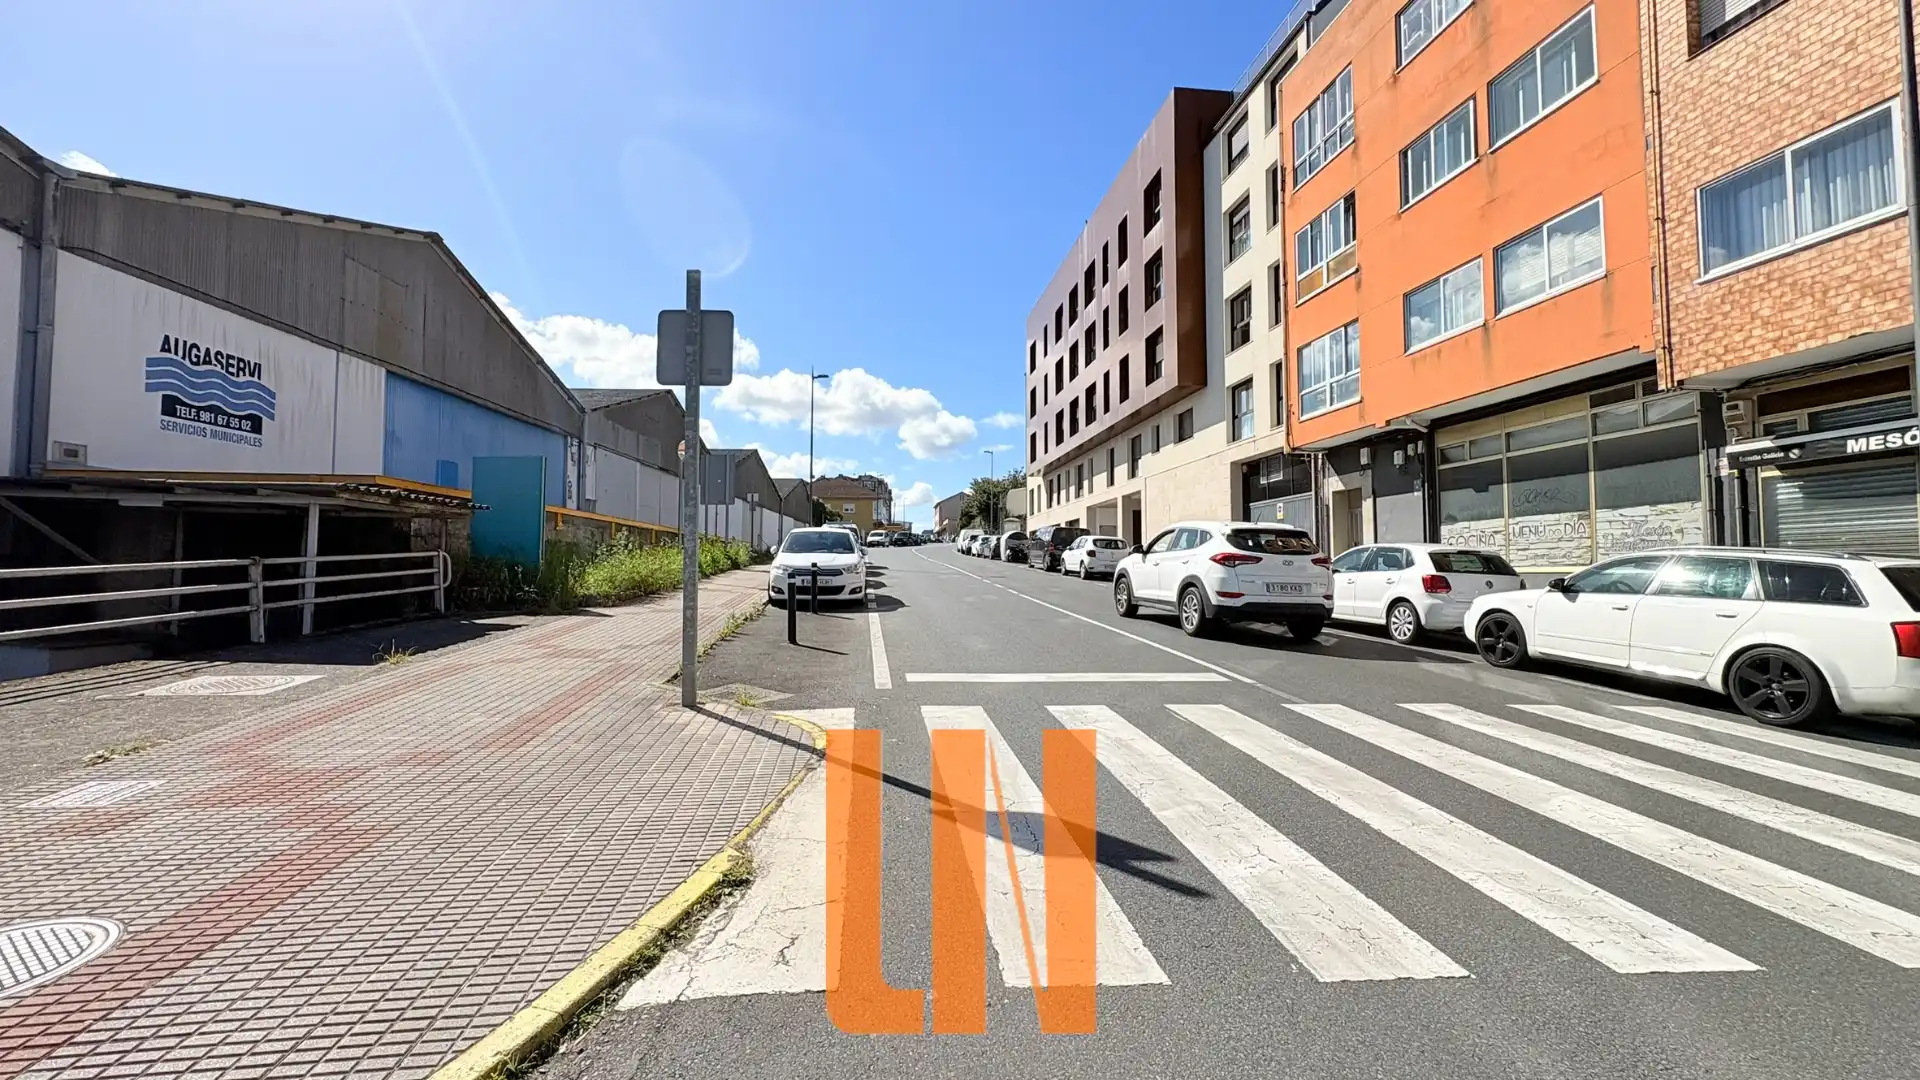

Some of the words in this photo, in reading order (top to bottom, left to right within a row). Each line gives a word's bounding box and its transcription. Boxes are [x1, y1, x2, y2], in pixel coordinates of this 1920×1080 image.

[160, 334, 262, 381] AUGASERVI
[175, 405, 198, 420] TELF.
[199, 410, 215, 423] 981
[218, 414, 228, 426] 67
[229, 416, 240, 428] 55
[241, 419, 252, 431] 02
[159, 419, 207, 438] SERVICIOS
[210, 428, 263, 448] MUNICIPALES
[1512, 521, 1546, 539] MENÚ
[1564, 518, 1587, 537] DÍA
[1271, 583, 1289, 592] 3180
